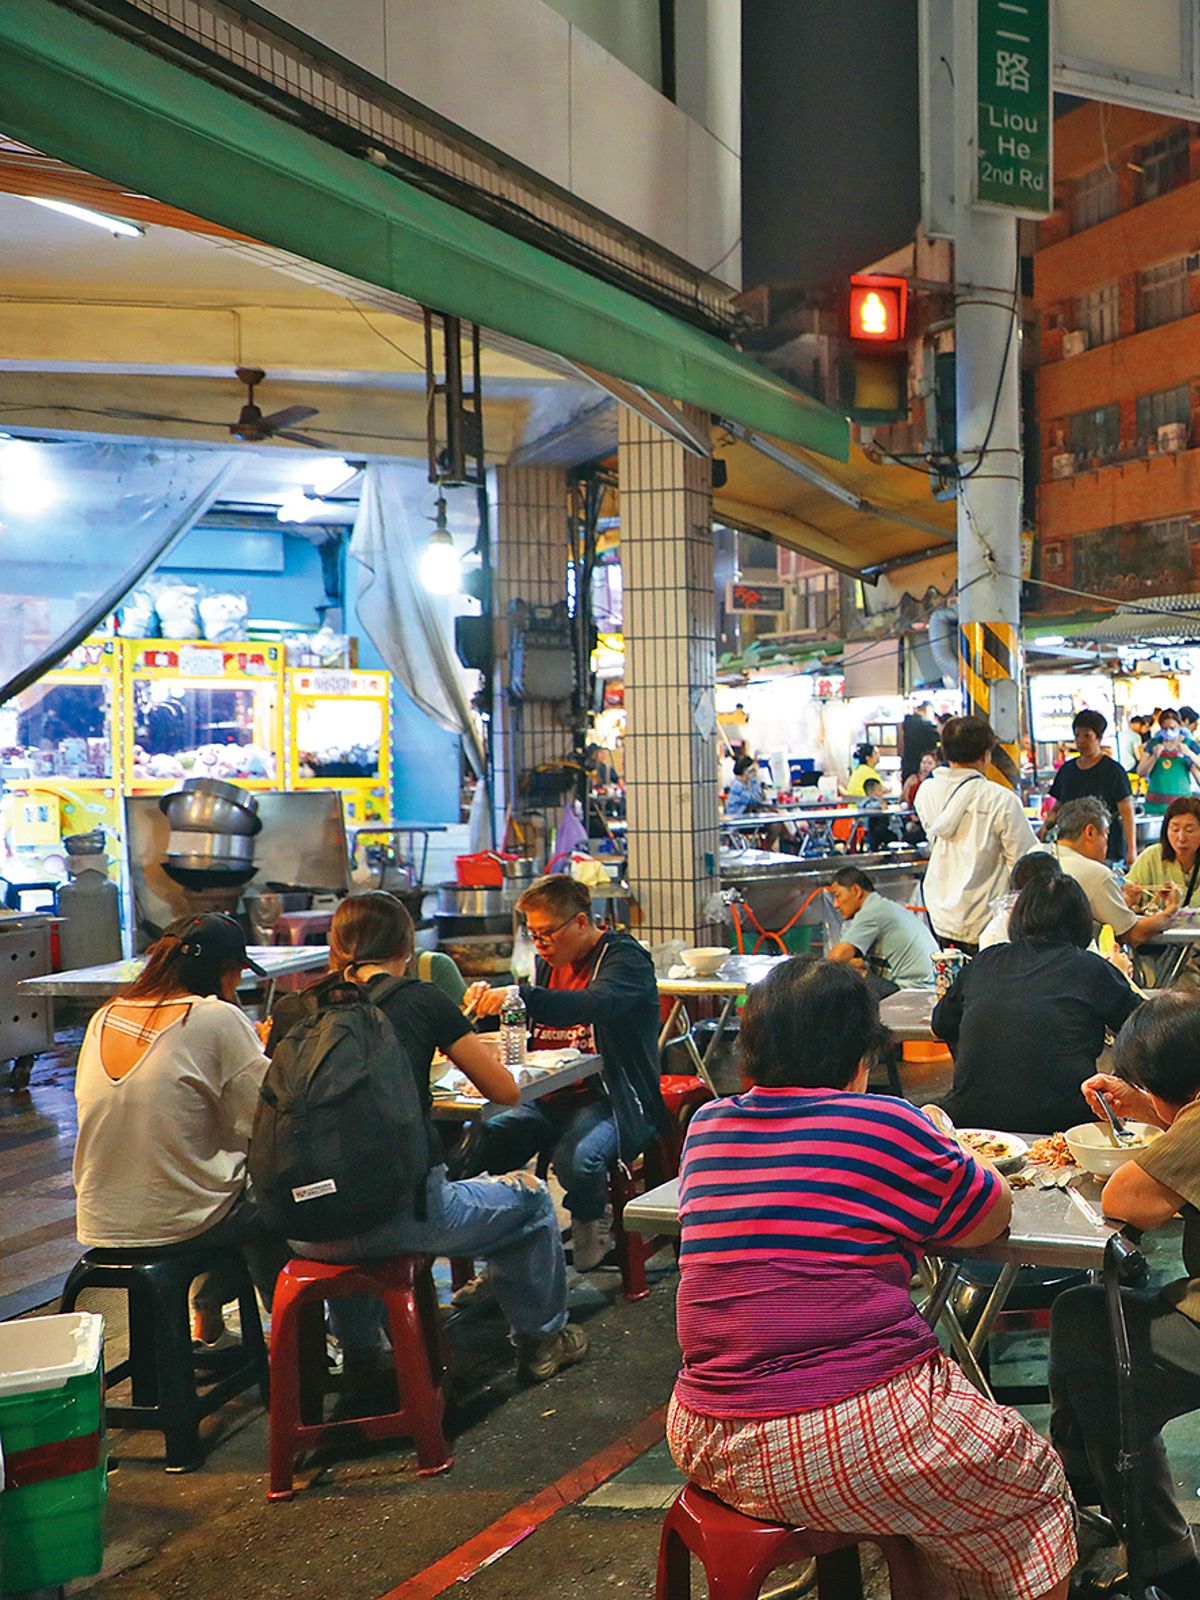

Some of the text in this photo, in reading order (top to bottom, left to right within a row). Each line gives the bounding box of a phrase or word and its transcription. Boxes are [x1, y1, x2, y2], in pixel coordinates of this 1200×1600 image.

[996, 2, 1031, 94] 二路
[988, 106, 1038, 133] Liou
[998, 135, 1031, 160] He
[981, 161, 1044, 191] 2nd Rd
